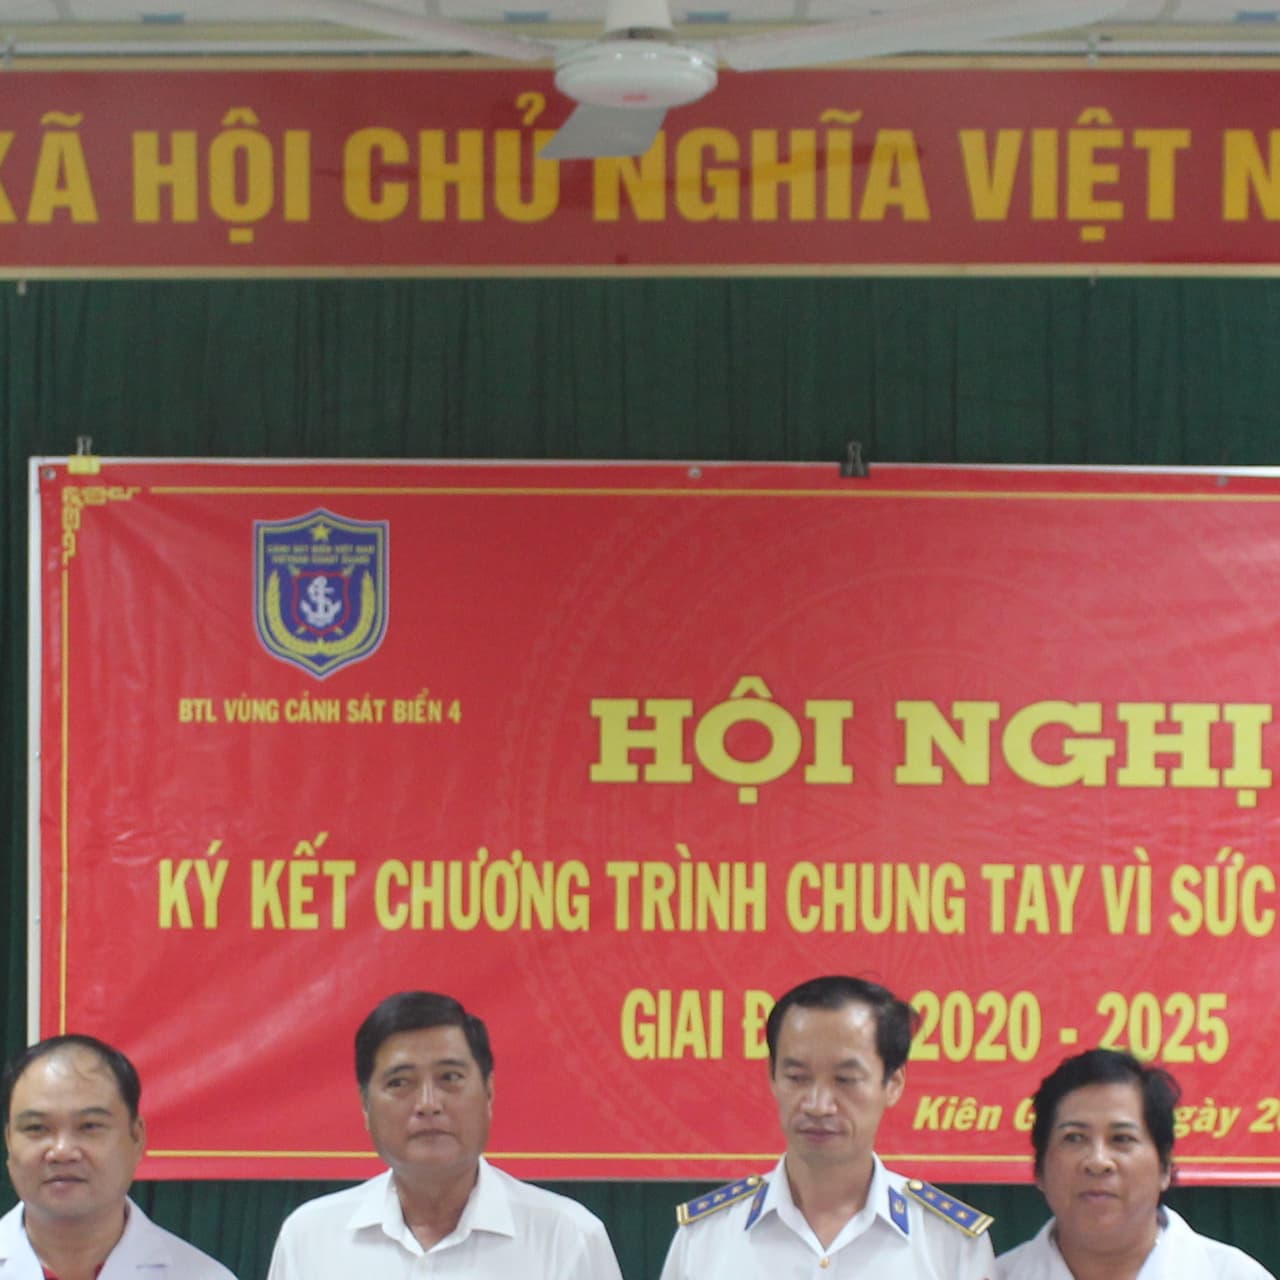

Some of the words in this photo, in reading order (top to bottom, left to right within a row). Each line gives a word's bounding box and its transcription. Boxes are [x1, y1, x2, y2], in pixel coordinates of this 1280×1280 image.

[133, 108, 312, 245] HỘI
[344, 92, 561, 224] CHỦ
[593, 108, 930, 222] NGHĨA
[960, 108, 1191, 242] VIỆT
[178, 698, 217, 723] BTL
[224, 692, 280, 723] VÙNG
[347, 693, 386, 723] SÁT
[392, 688, 442, 724] BIỂN
[448, 699, 462, 724] 4
[590, 676, 854, 804] HỘI
[895, 700, 1273, 808] NGHỊ
[159, 840, 229, 930] KÝ
[251, 832, 356, 931] KẾT
[375, 848, 590, 932] CHƯƠNG
[606, 844, 767, 933] TRÌNH
[786, 860, 966, 935] CHUNG
[981, 862, 1084, 935] TAY
[1100, 847, 1153, 936] VÌ
[1169, 846, 1276, 938] SỨC
[621, 988, 723, 1061] GIAI
[908, 989, 1042, 1063] 2020
[1060, 1027, 1077, 1045] -
[1096, 992, 1230, 1064] 2025
[913, 1095, 1003, 1132] Kiên
[1172, 1098, 1241, 1139] gày
